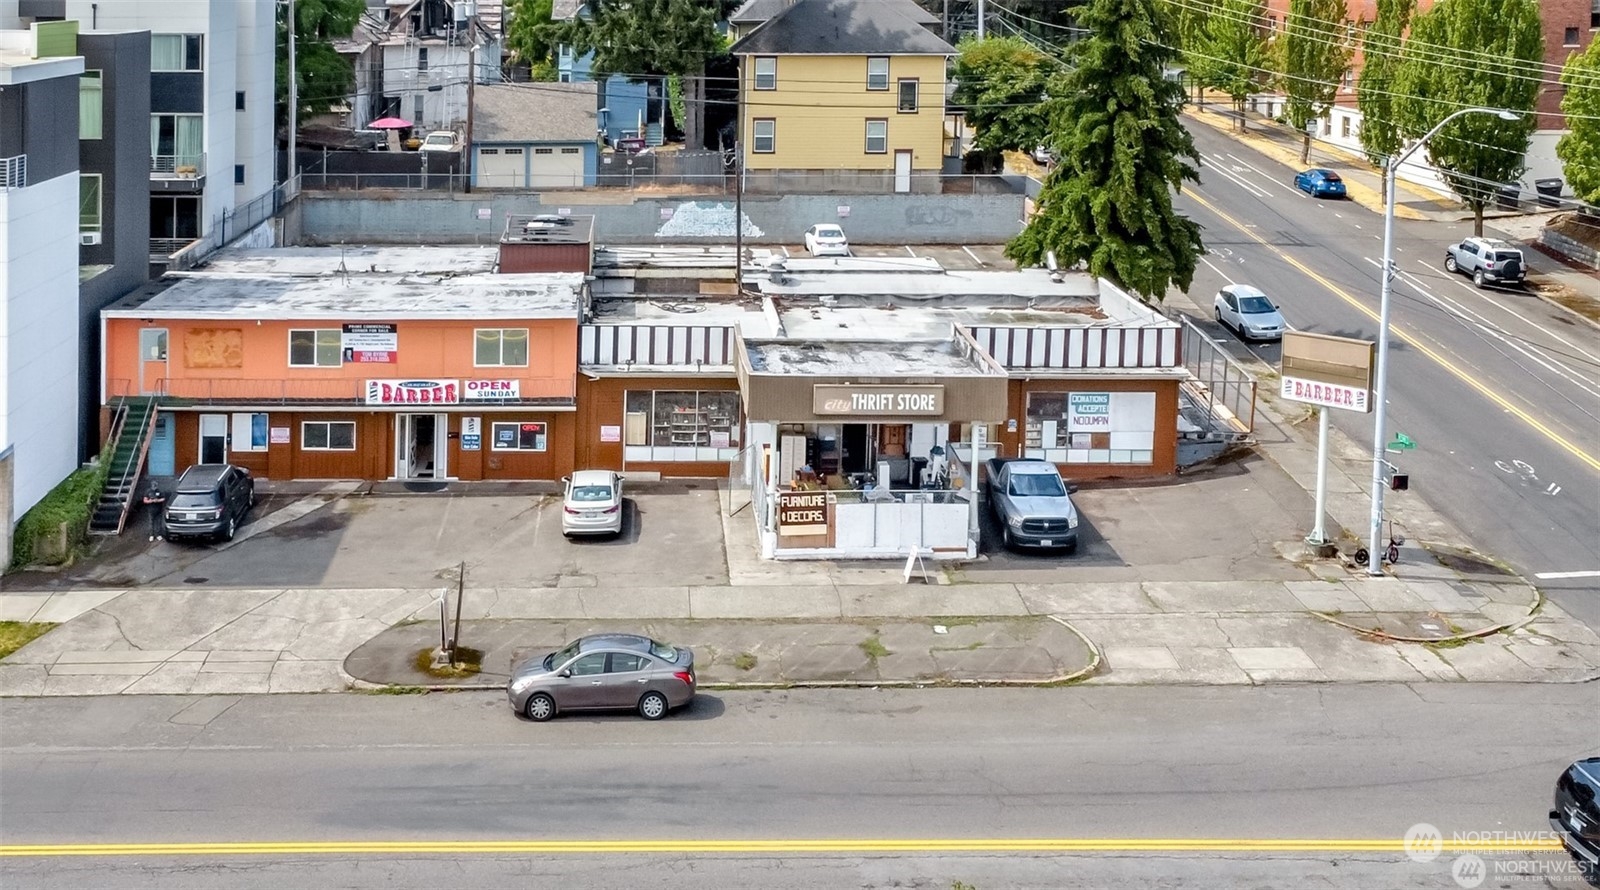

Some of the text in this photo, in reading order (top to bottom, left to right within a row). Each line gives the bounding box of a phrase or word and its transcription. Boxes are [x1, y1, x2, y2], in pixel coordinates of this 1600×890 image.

[468, 381, 511, 390] OPEN
[381, 383, 457, 403] BARBER
[1072, 395, 1108, 403] DONATIONS
[1295, 381, 1354, 406] BARBER
[824, 393, 935, 411] city THRIFT STORE
[1073, 416, 1084, 425] NO
[781, 495, 825, 507] FURNITURE
